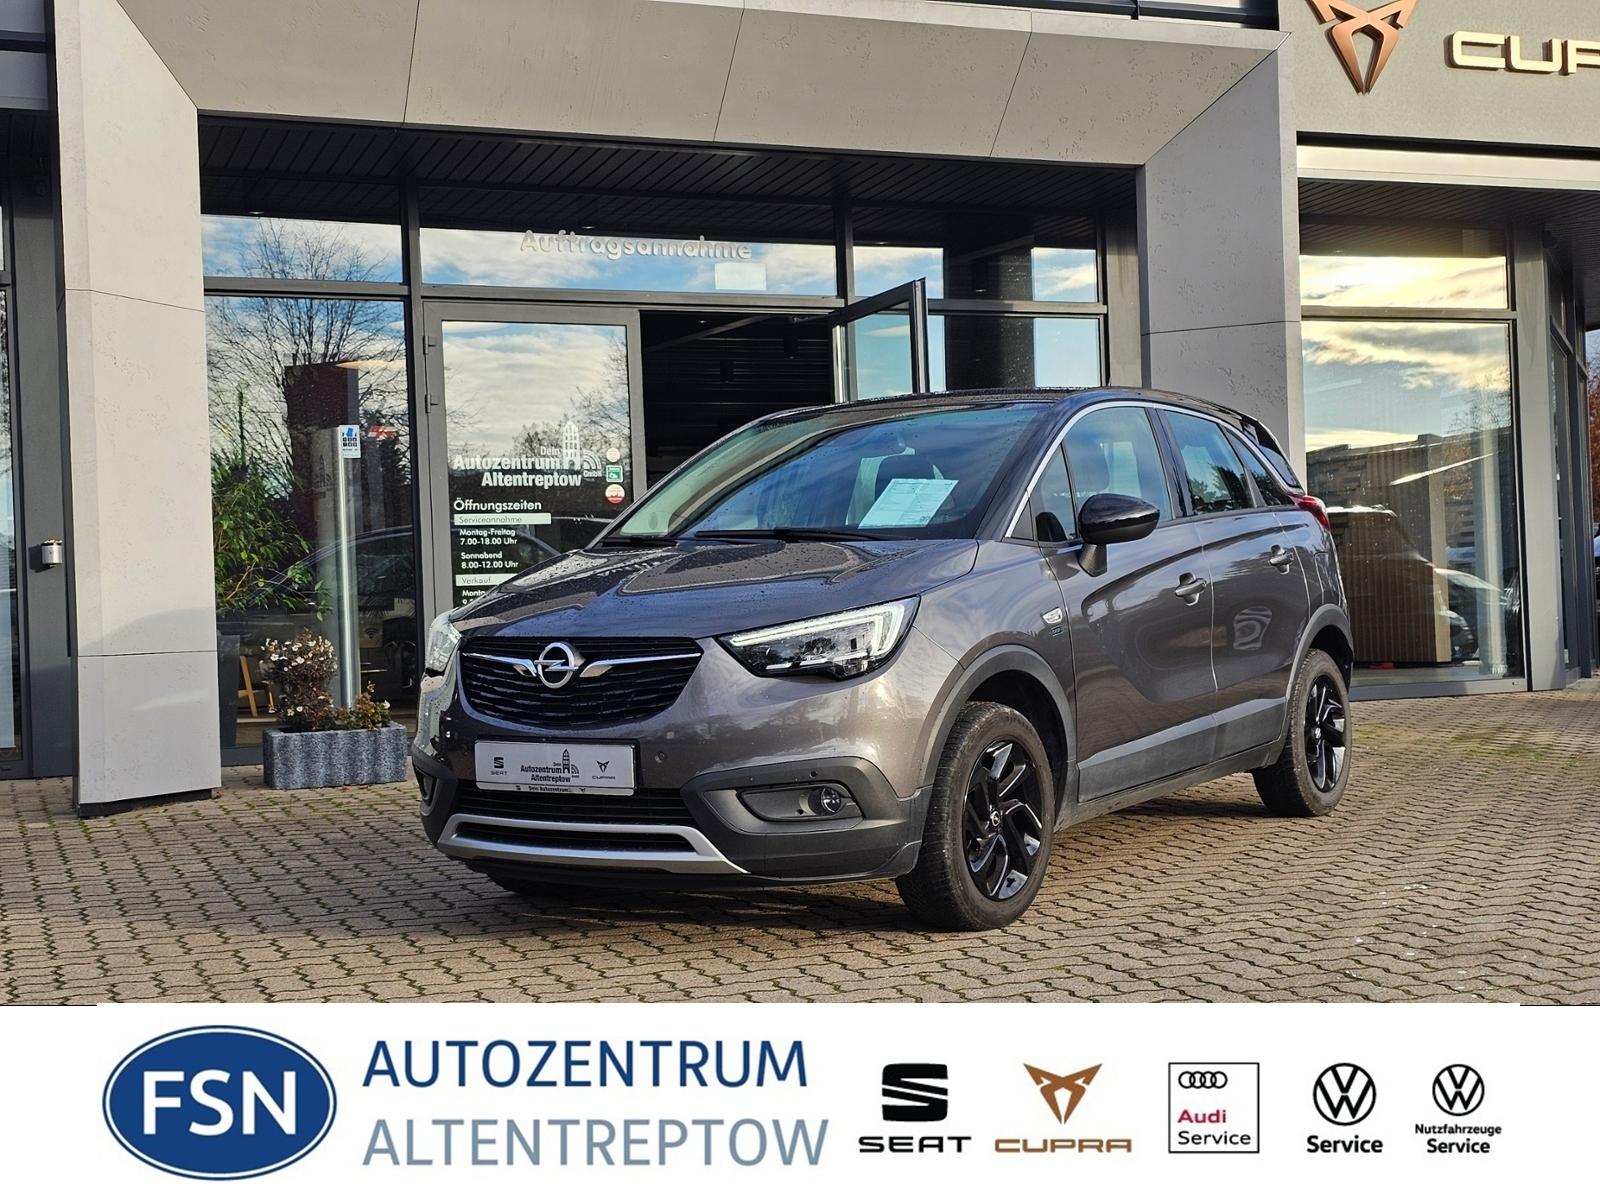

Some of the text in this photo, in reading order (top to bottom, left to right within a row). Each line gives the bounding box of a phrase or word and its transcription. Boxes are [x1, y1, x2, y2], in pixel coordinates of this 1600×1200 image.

[520, 229, 752, 260] Auftragsannahme
[540, 446, 560, 455] Dein
[452, 455, 561, 470] Autozentrum
[481, 472, 582, 489] Altentreptow
[453, 498, 542, 512] Öffnungszeiten
[459, 515, 523, 524] Serviceannahme
[459, 529, 516, 538] Montag-Freitag
[460, 537, 518, 545] 7.00-18.00 Uhr
[461, 551, 503, 559] Sonnabend
[461, 560, 519, 569] 8.00-12.00 Uhr
[462, 576, 492, 585] Verkauf
[520, 765, 562, 774] Autozentrum
[531, 774, 571, 783] Altentreptow
